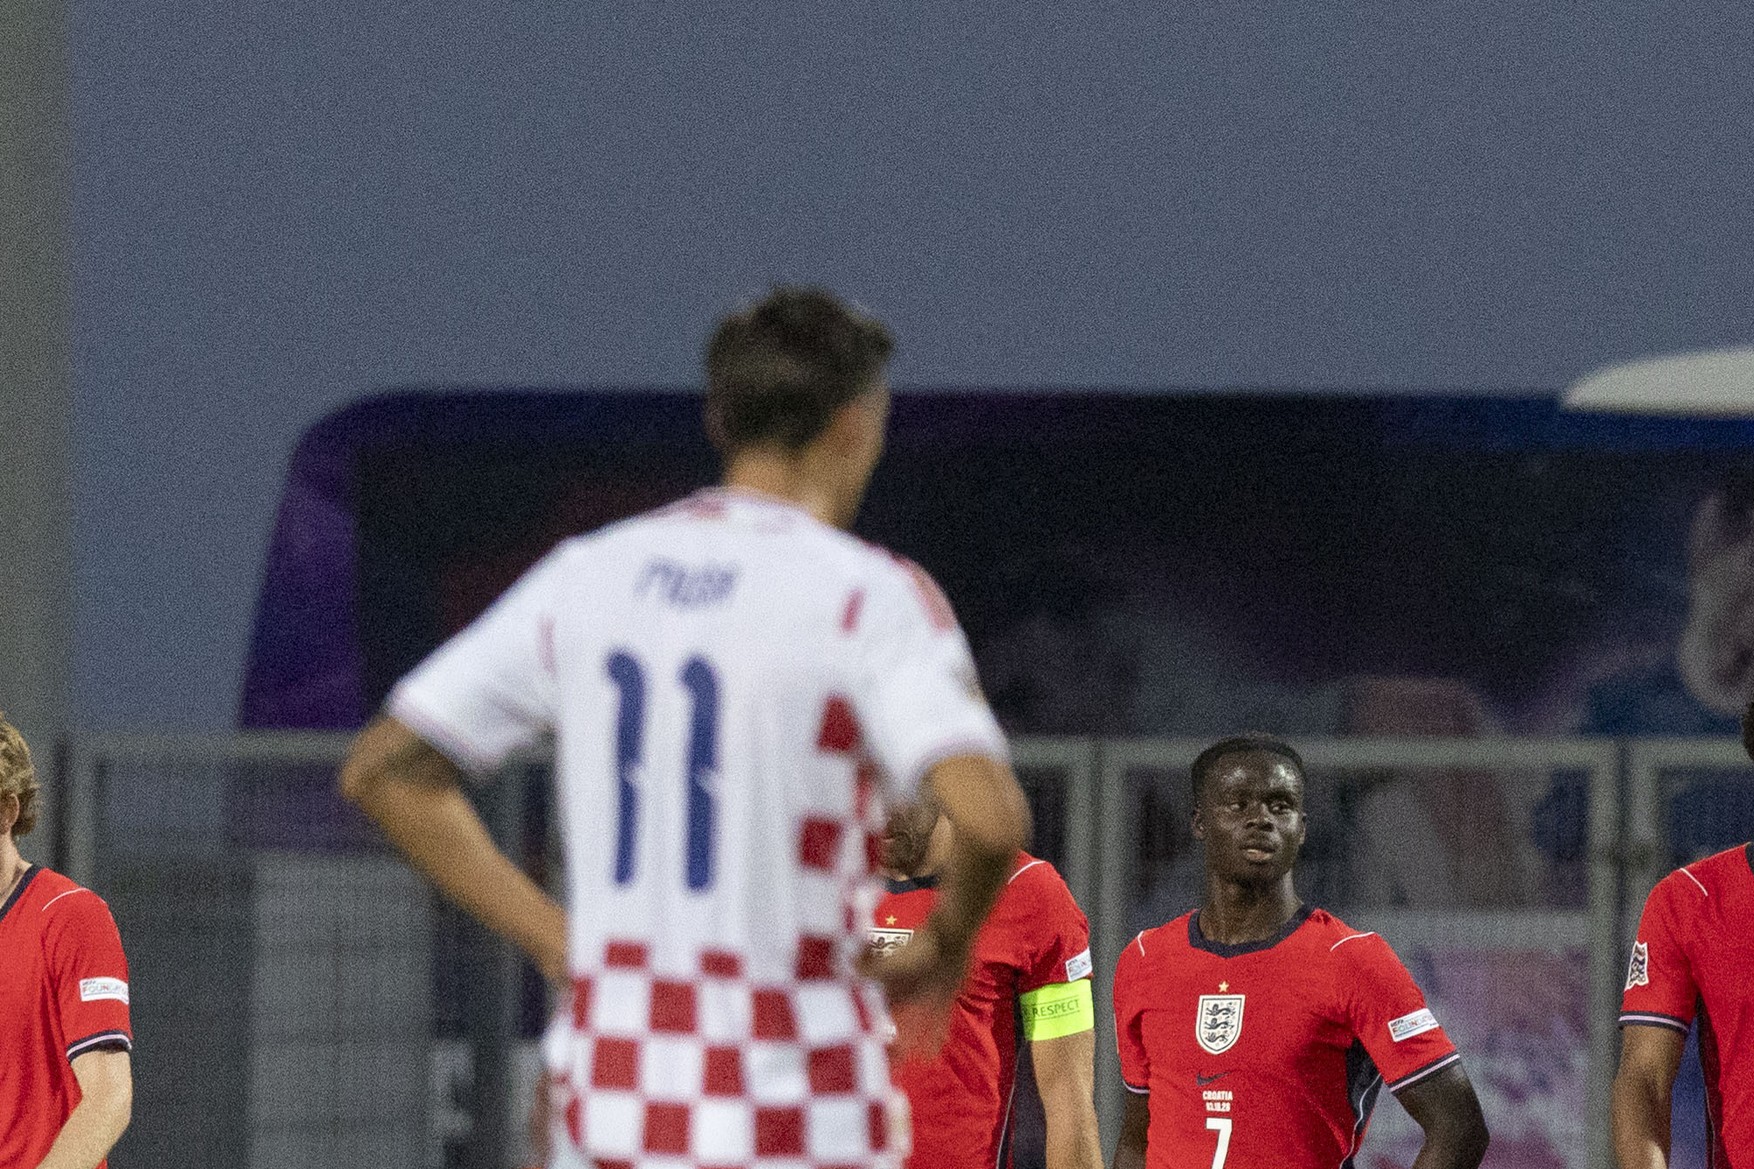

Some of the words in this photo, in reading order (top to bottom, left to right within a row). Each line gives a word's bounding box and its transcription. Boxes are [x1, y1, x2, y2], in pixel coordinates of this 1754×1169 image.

[605, 645, 722, 892] 11
[1032, 998, 1080, 1018] RESPECT
[1202, 1091, 1234, 1101] CROATIA
